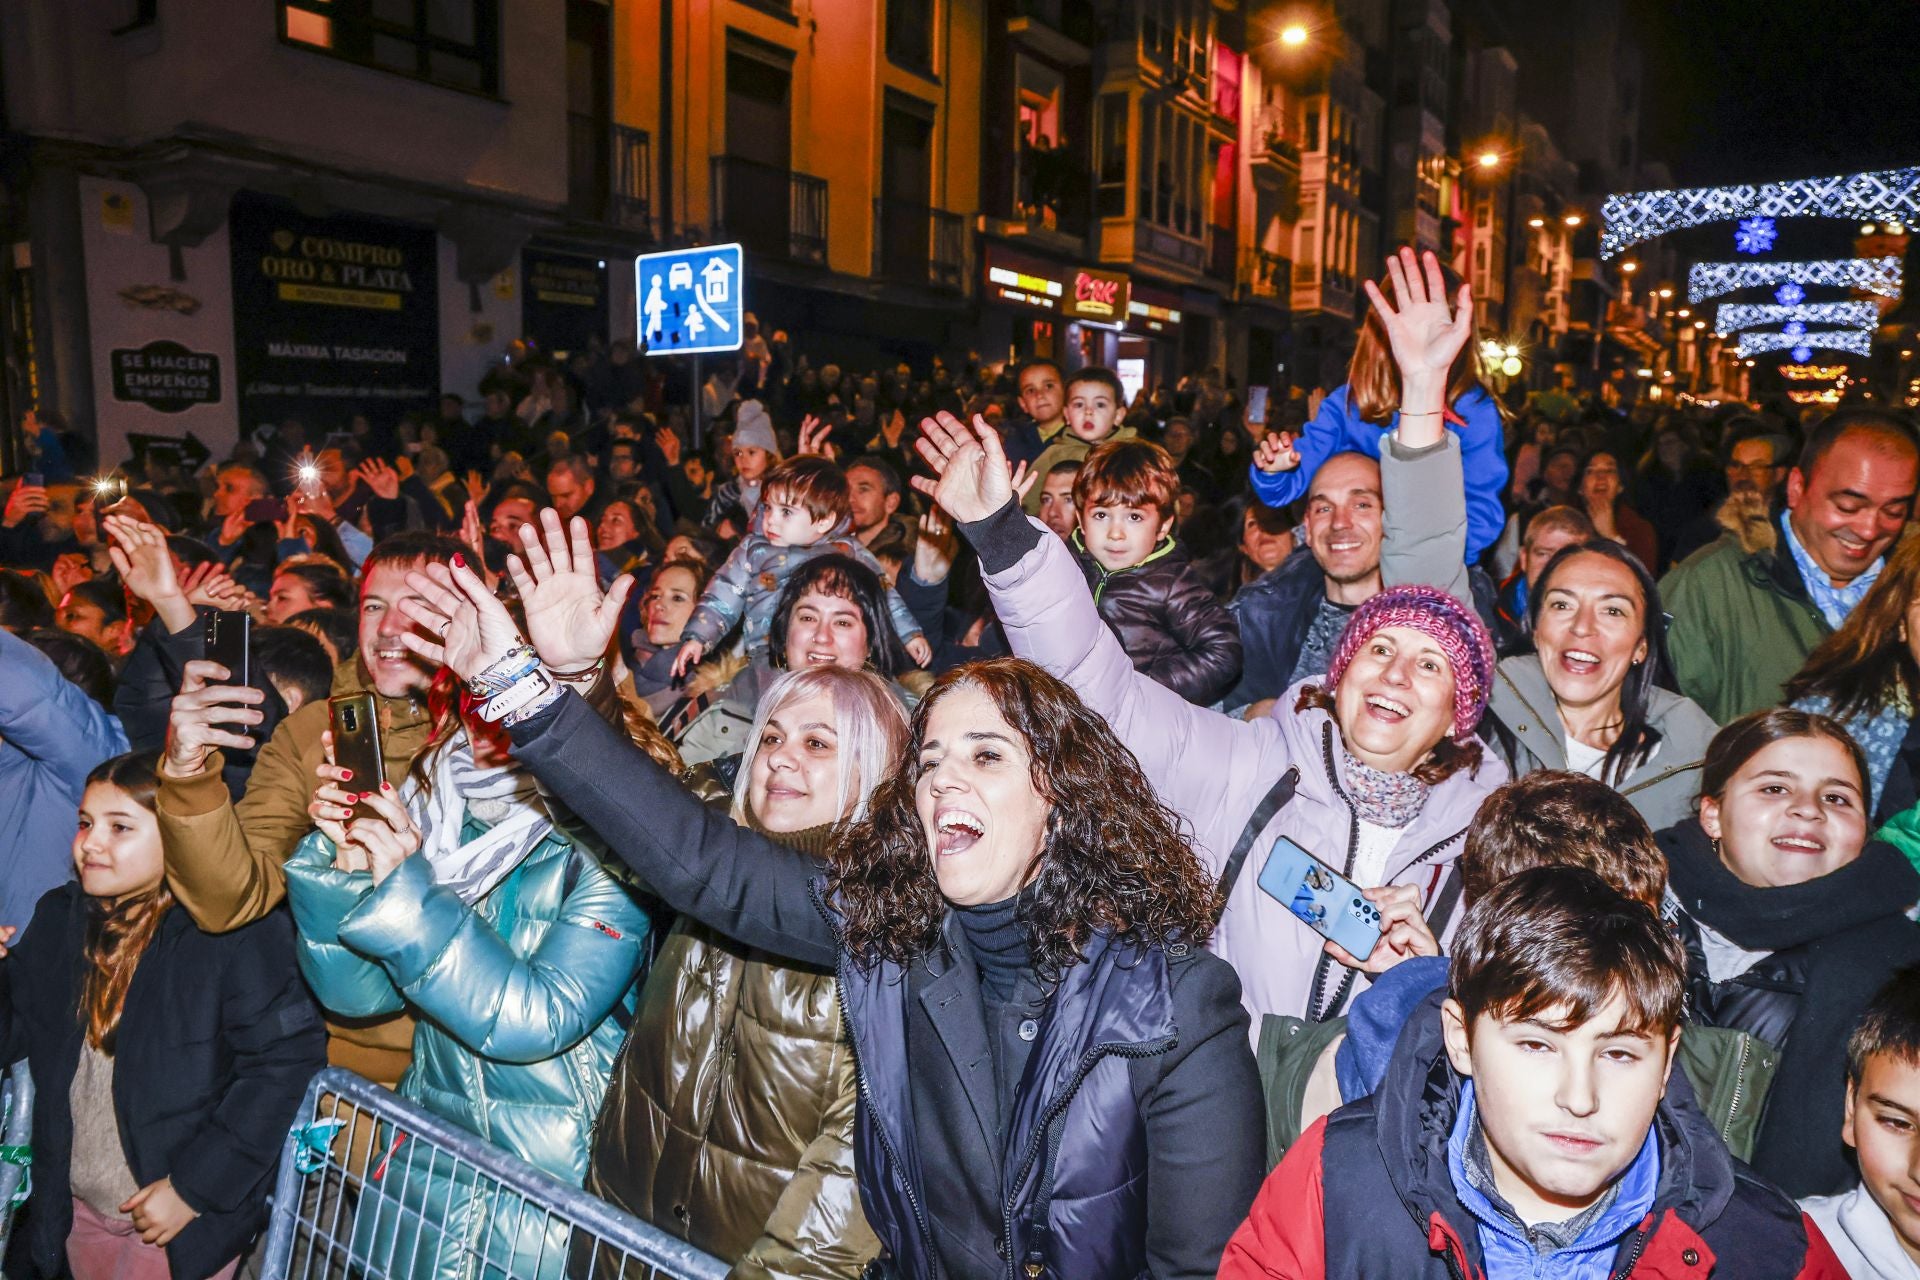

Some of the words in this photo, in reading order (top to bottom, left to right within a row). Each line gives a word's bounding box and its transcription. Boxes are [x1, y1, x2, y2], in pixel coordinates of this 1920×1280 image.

[300, 236, 402, 267] COMPRO
[261, 256, 315, 280] ORO
[320, 264, 336, 283] &
[341, 265, 413, 291] PLATA
[120, 353, 144, 368] SE
[149, 355, 210, 371] HACEN
[125, 371, 210, 388] EMPEÑOS
